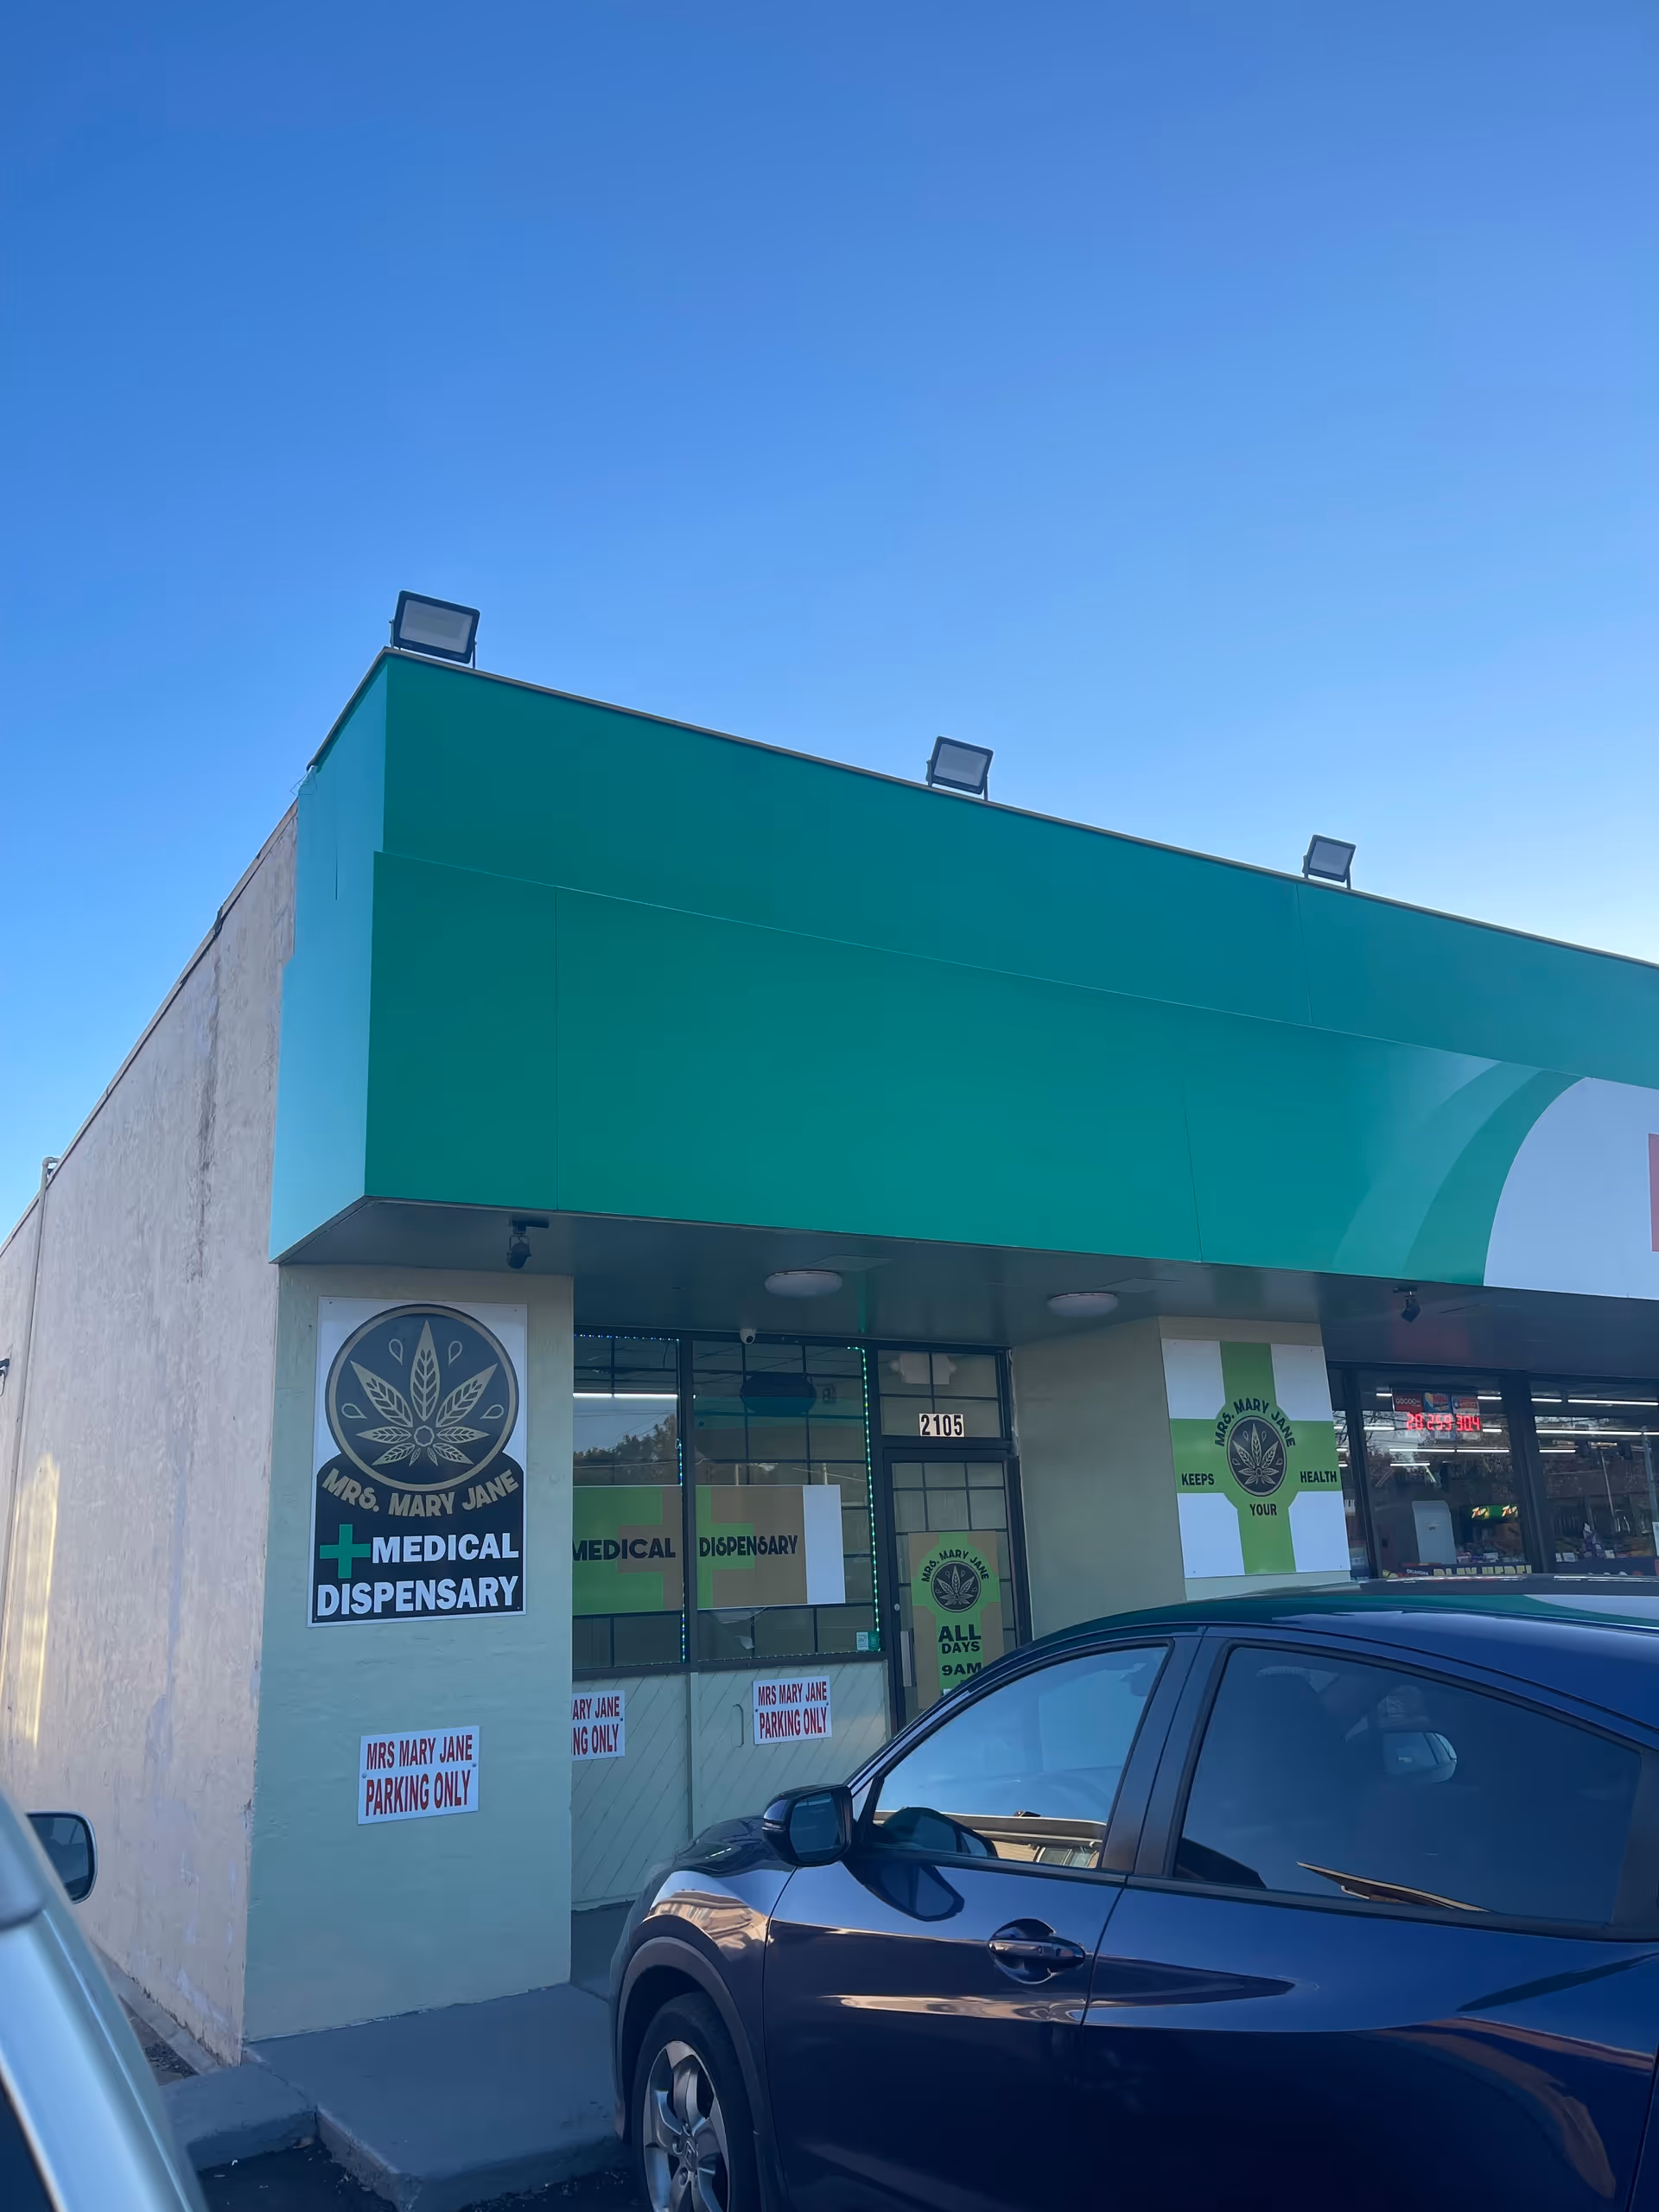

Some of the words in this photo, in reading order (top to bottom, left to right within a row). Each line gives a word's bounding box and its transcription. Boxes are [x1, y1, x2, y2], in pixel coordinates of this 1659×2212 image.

[921, 1414, 963, 1436] 2105
[1215, 1412, 1235, 1447] MRS.
[1233, 1397, 1269, 1414] MARY
[1271, 1411, 1296, 1448] JANE
[1181, 1473, 1215, 1485] KEEPS
[1300, 1471, 1338, 1484] HEALTH
[321, 1468, 379, 1512] MRS.
[388, 1491, 455, 1517] MARY
[461, 1469, 519, 1511] JANE
[1249, 1503, 1277, 1516] YOUR
[372, 1533, 519, 1564] MEDICAL
[572, 1537, 676, 1561] MEDICAL
[699, 1535, 798, 1557] DISPENSARY
[921, 1559, 939, 1583] MRS.
[939, 1549, 969, 1560] MARY
[969, 1556, 989, 1580] JANE
[317, 1575, 518, 1617] DISPENSARY
[938, 1624, 982, 1642] ALL
[941, 1641, 981, 1654] DAYS
[942, 1662, 982, 1676] 9AM
[758, 1687, 776, 1706] MRS
[779, 1683, 804, 1703] MARY
[805, 1681, 827, 1702] JANE
[572, 1699, 592, 1720] ARY
[595, 1696, 620, 1719] JANE
[760, 1709, 801, 1739] PARKING
[804, 1707, 828, 1735] ONLY
[591, 1724, 619, 1753] ONLY
[366, 1741, 395, 1770] MRS
[399, 1738, 436, 1767] MARY
[440, 1734, 473, 1764] JANE
[365, 1773, 429, 1816] PARKING
[434, 1770, 471, 1809] ONLY
